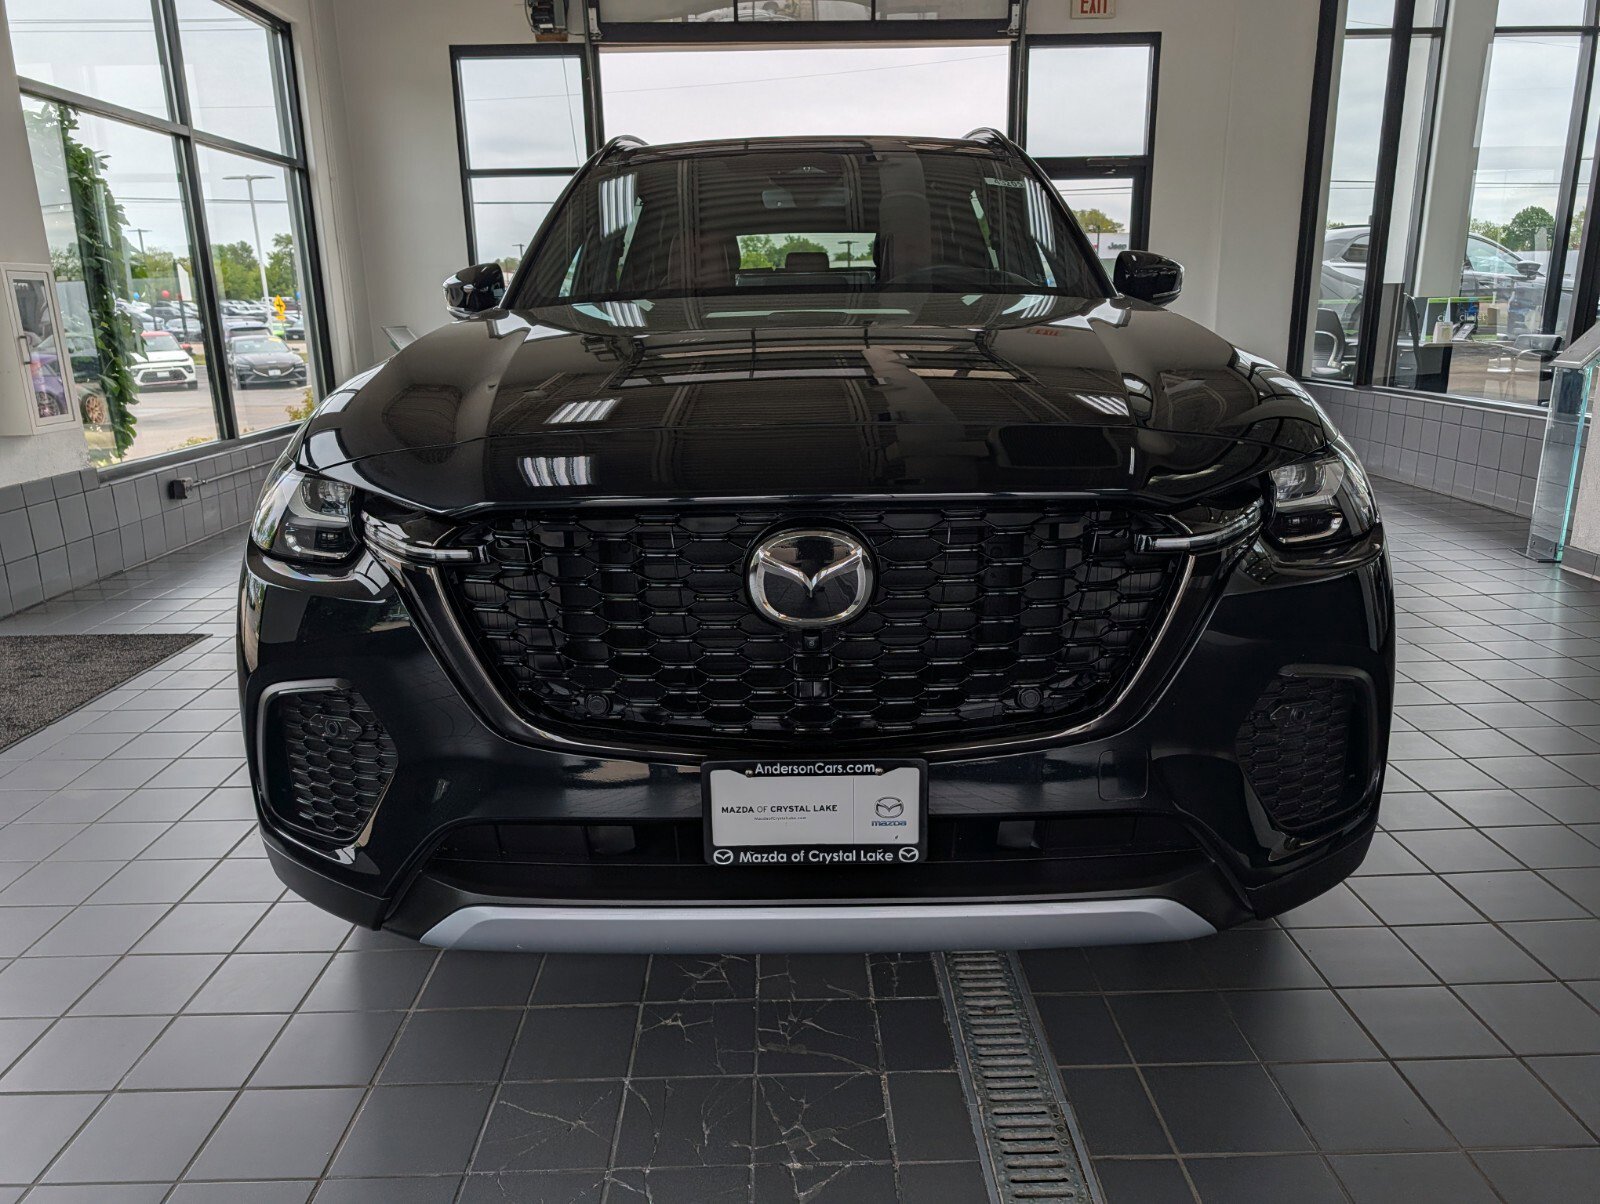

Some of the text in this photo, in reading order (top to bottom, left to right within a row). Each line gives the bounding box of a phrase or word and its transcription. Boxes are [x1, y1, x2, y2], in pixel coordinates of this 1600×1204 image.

[754, 763, 876, 776] AndersonCars.com
[721, 804, 838, 814] MAZDA OF CRYSTAL LAKE
[739, 849, 894, 864] Mazda of Crystal Lake
